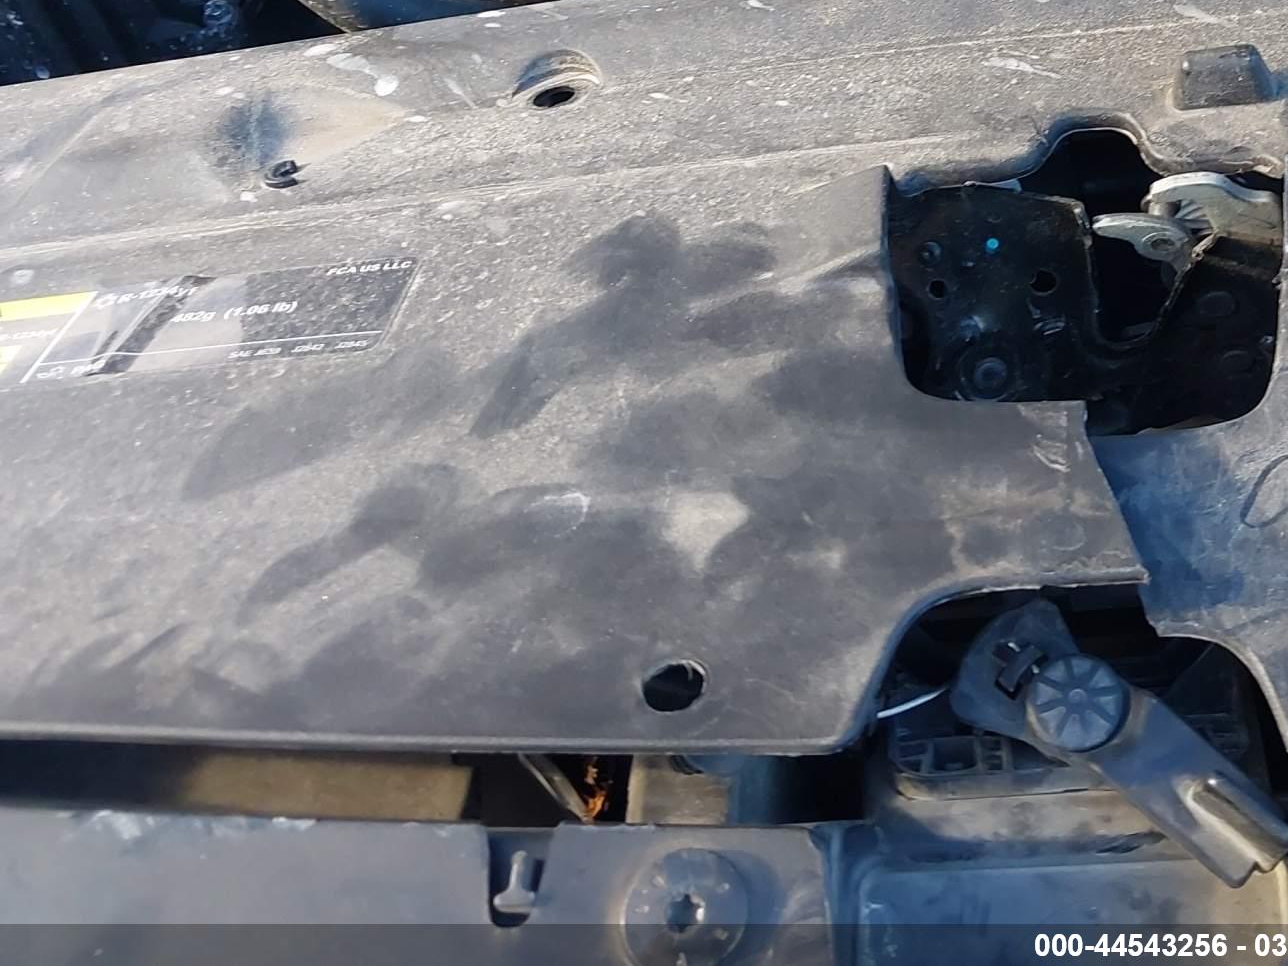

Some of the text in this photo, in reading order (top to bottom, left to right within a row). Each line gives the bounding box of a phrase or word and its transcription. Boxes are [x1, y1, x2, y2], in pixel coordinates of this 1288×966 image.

[326, 260, 412, 276] FCA US LLC
[171, 309, 215, 324] 482g
[223, 303, 269, 321] (1.06
